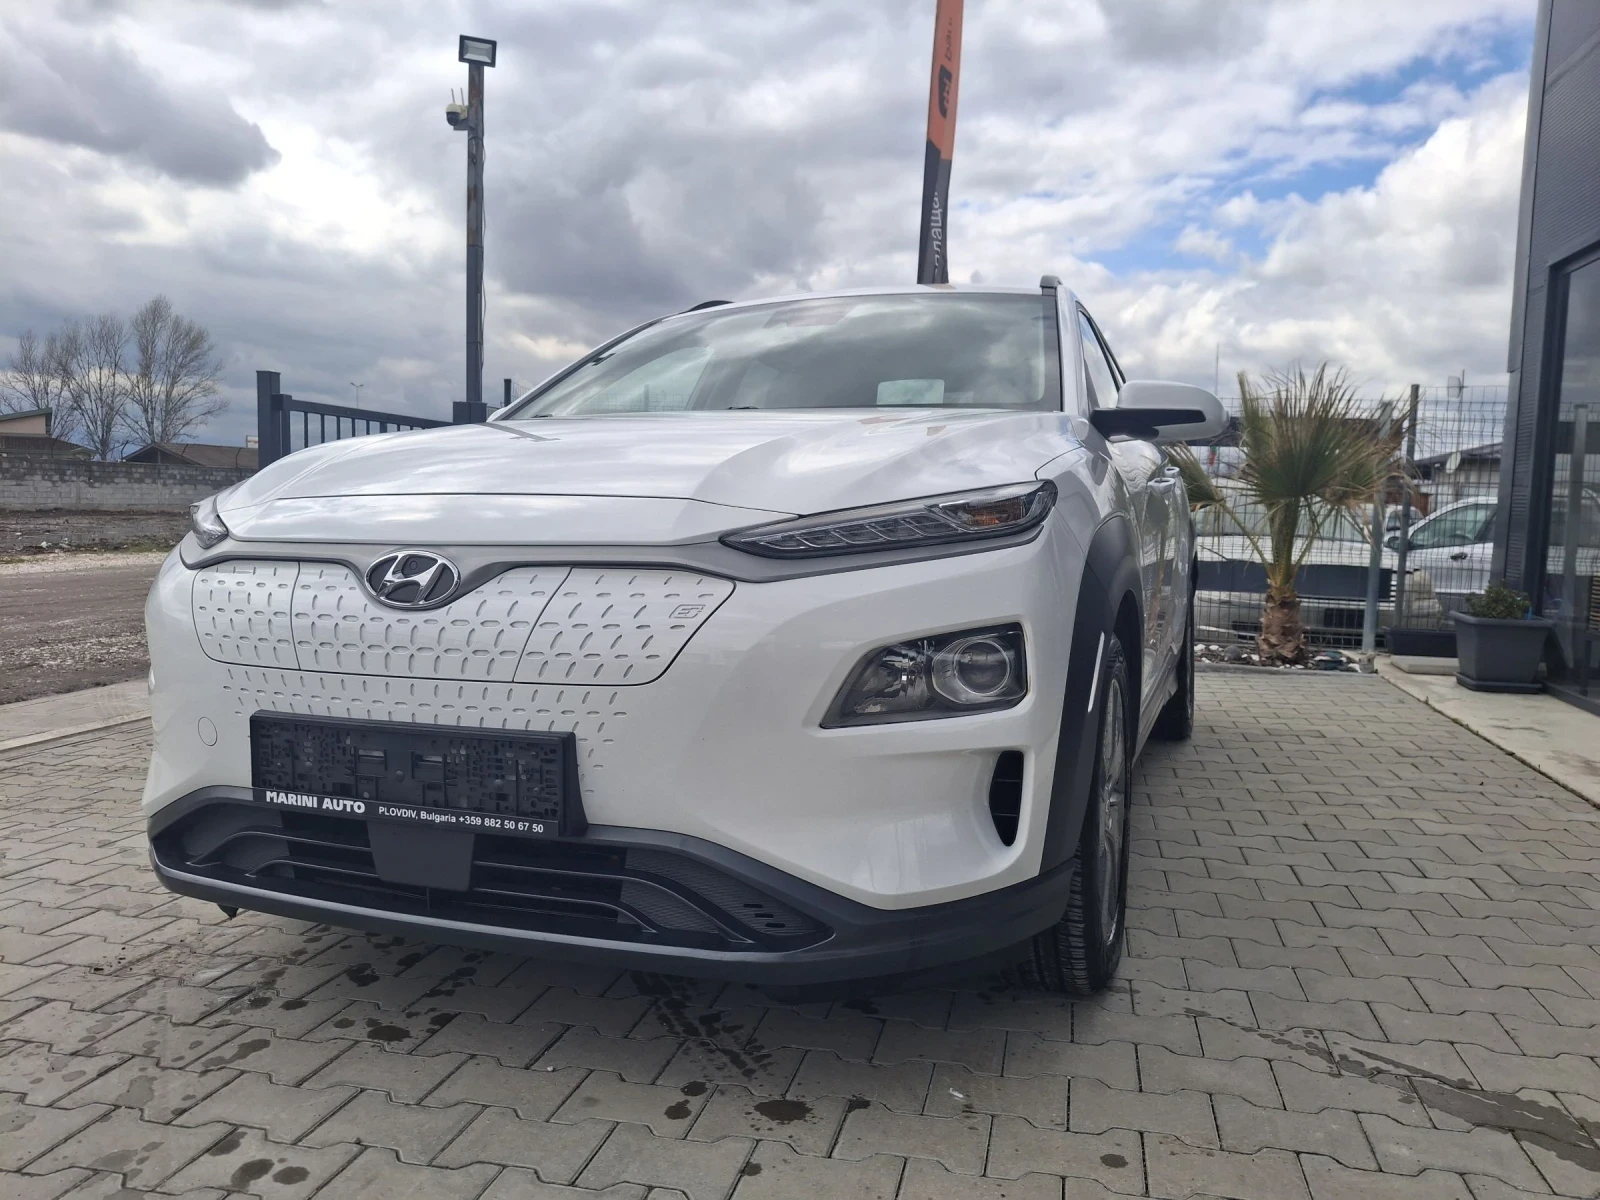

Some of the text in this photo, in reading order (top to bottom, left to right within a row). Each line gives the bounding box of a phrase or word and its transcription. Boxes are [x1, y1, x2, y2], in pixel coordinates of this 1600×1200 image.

[266, 791, 544, 833] MARINI AUTO PLOVDIV, Bulgaria +359 882 50 67 50
